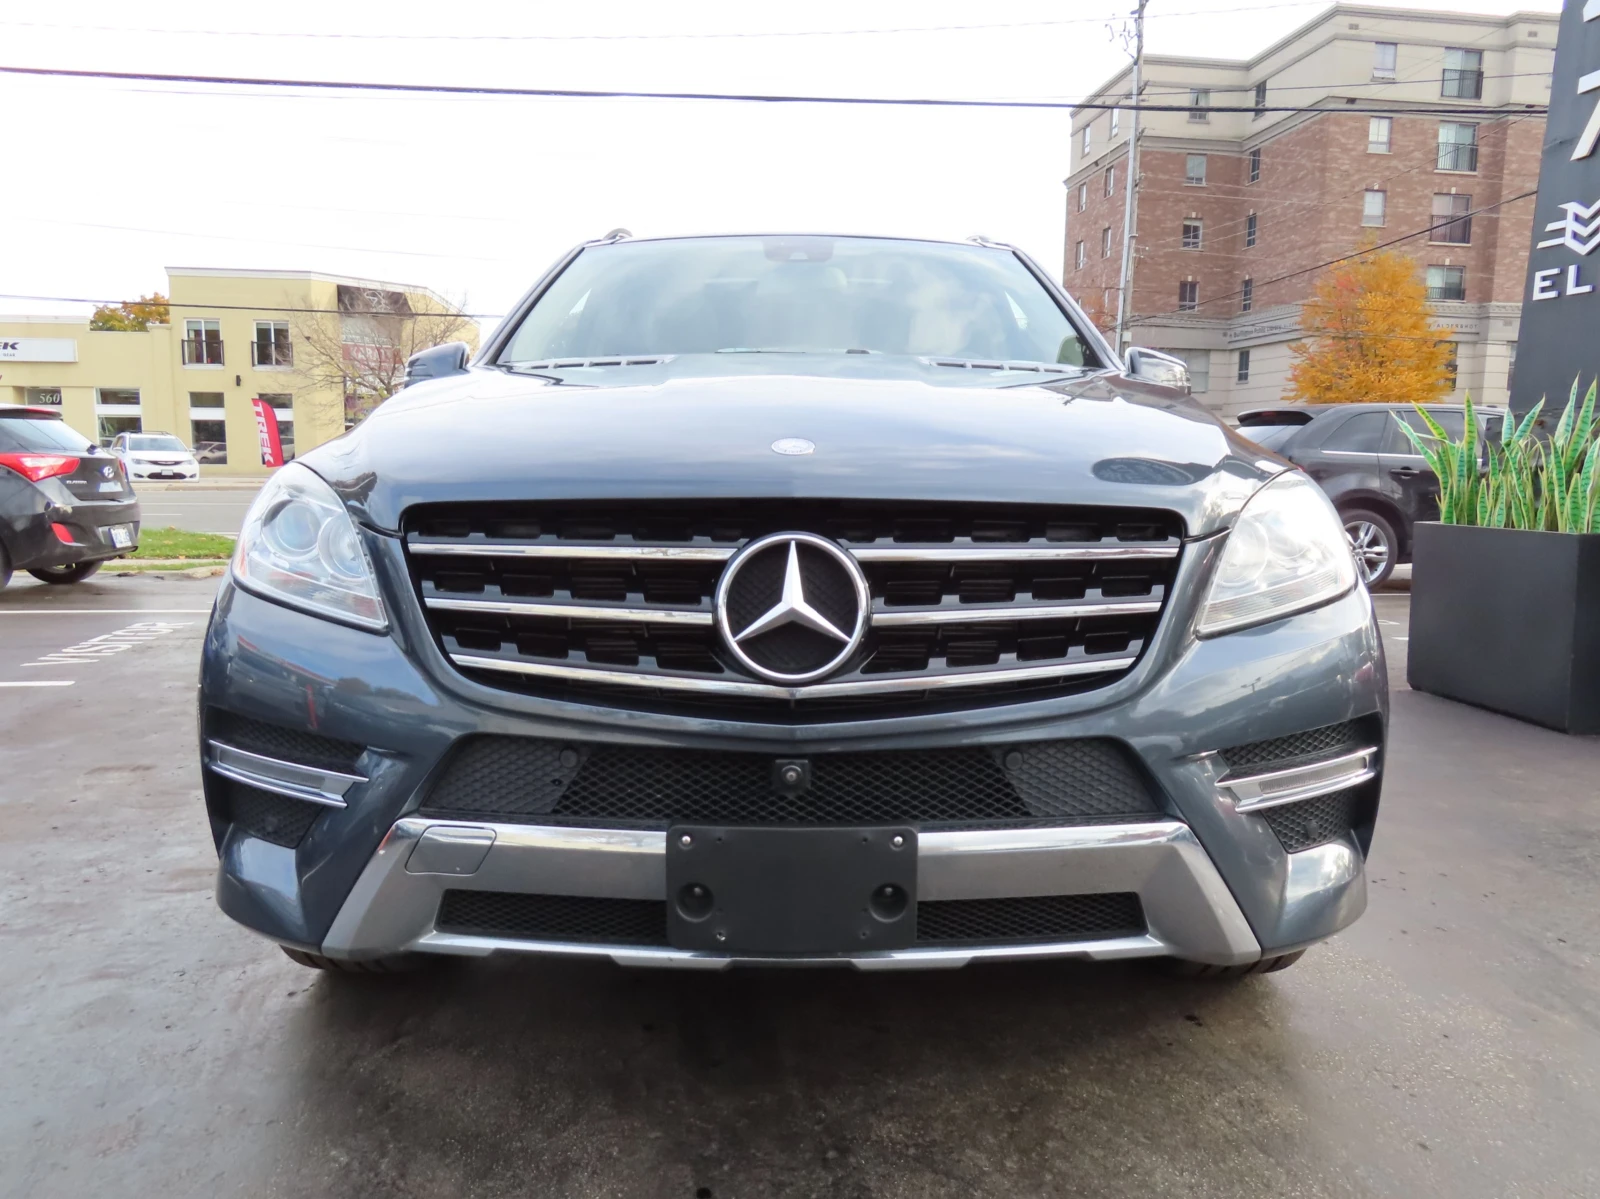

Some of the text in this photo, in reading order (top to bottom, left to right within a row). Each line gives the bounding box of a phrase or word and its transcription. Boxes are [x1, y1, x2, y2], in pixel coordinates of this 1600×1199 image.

[39, 393, 60, 404] 560
[253, 401, 275, 464] TREK
[20, 621, 195, 667] VISITOR
